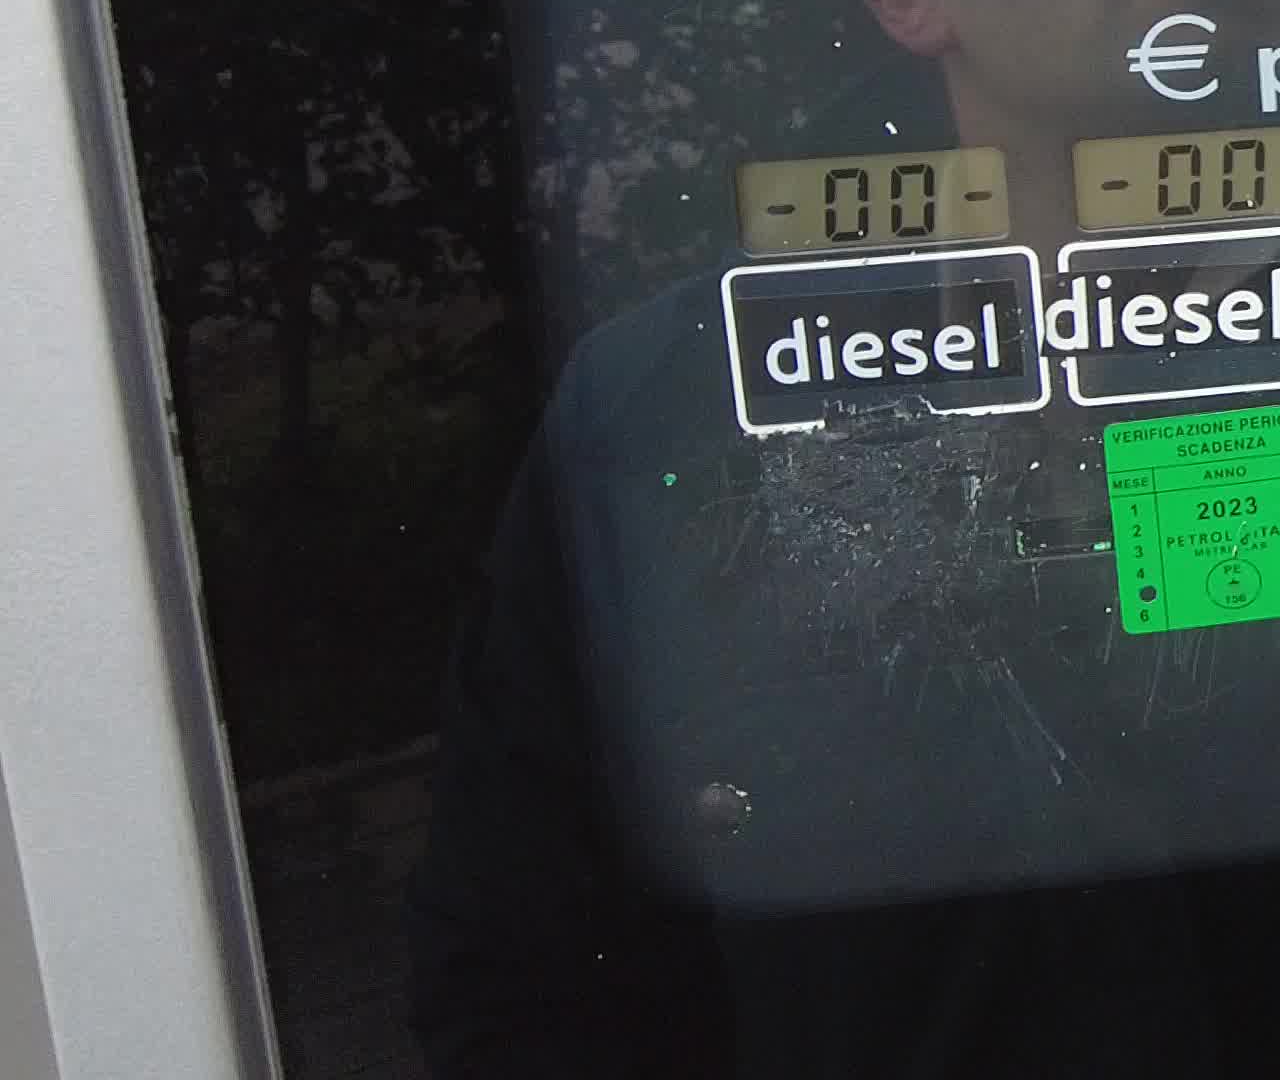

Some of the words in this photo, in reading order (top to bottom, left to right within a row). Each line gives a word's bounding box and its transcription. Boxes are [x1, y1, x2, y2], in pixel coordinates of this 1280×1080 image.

[1126, 13, 1218, 100] €
[765, 303, 1000, 384] diesel
[1112, 419, 1233, 444] VERIFICAZIONE
[1177, 436, 1266, 457] SCADENZA
[1203, 466, 1248, 481] ANNO
[1112, 476, 1149, 490] MESE
[1130, 504, 1138, 517] 1
[1196, 496, 1258, 520] 2023
[1133, 525, 1142, 537] 2
[1166, 531, 1233, 548] PETROL
[1135, 546, 1144, 558] 3
[1136, 568, 1145, 580] 4
[1140, 610, 1149, 623] 6
